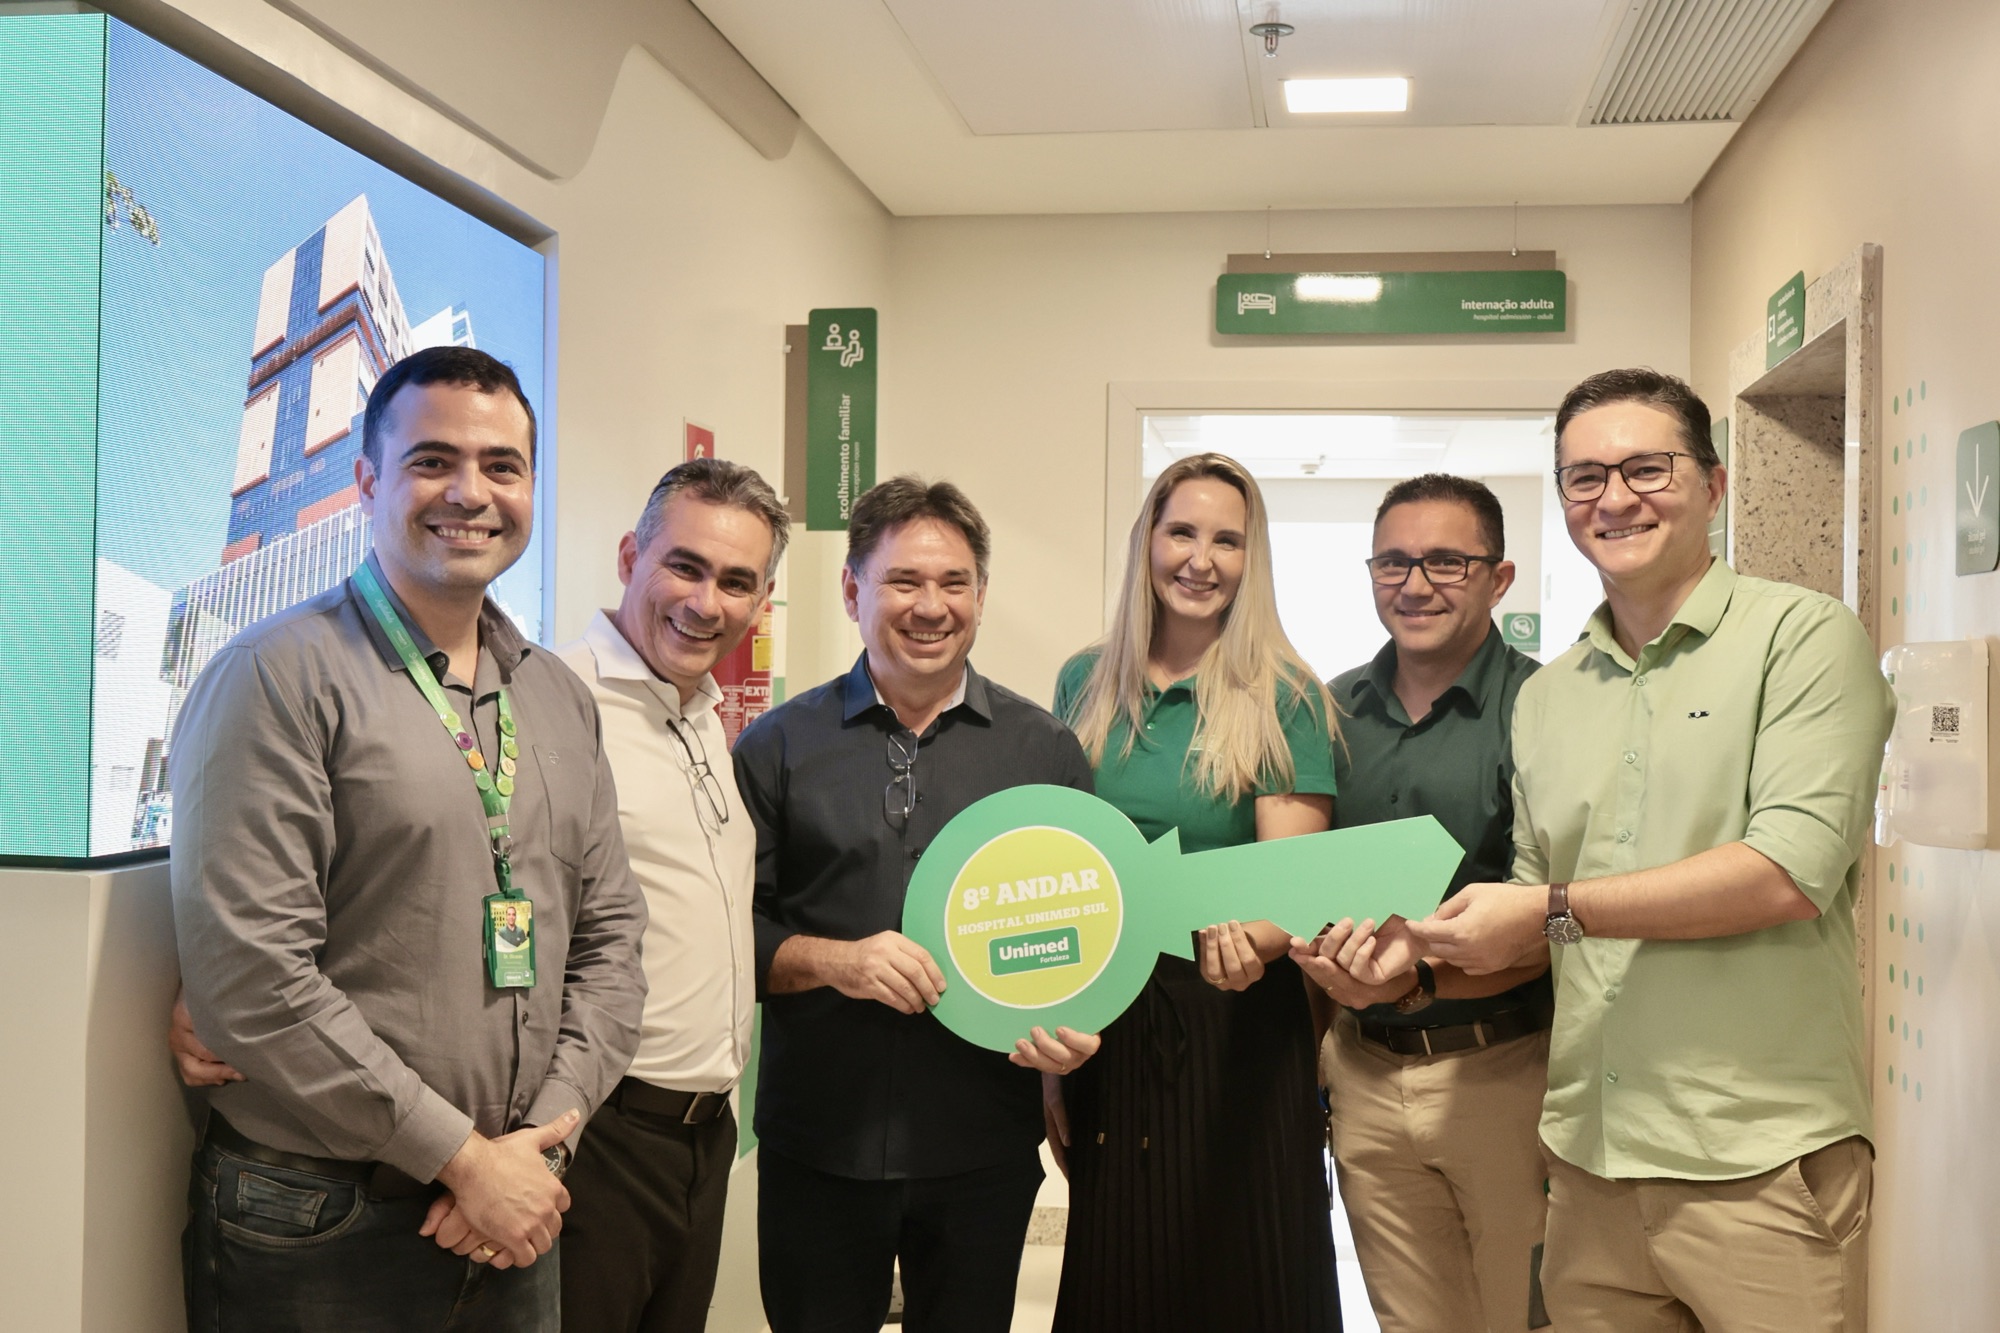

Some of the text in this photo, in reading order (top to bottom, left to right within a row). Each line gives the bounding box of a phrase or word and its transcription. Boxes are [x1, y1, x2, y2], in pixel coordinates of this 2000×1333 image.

[1461, 299, 1554, 312] internação adulta
[837, 393, 851, 520] acolhimento familiar
[995, 868, 1100, 906] ANDAR
[957, 902, 1109, 935] HOSPITAL UNIMED SUL
[999, 936, 1069, 961] Unimed
[1040, 954, 1070, 964] Fortaleza
